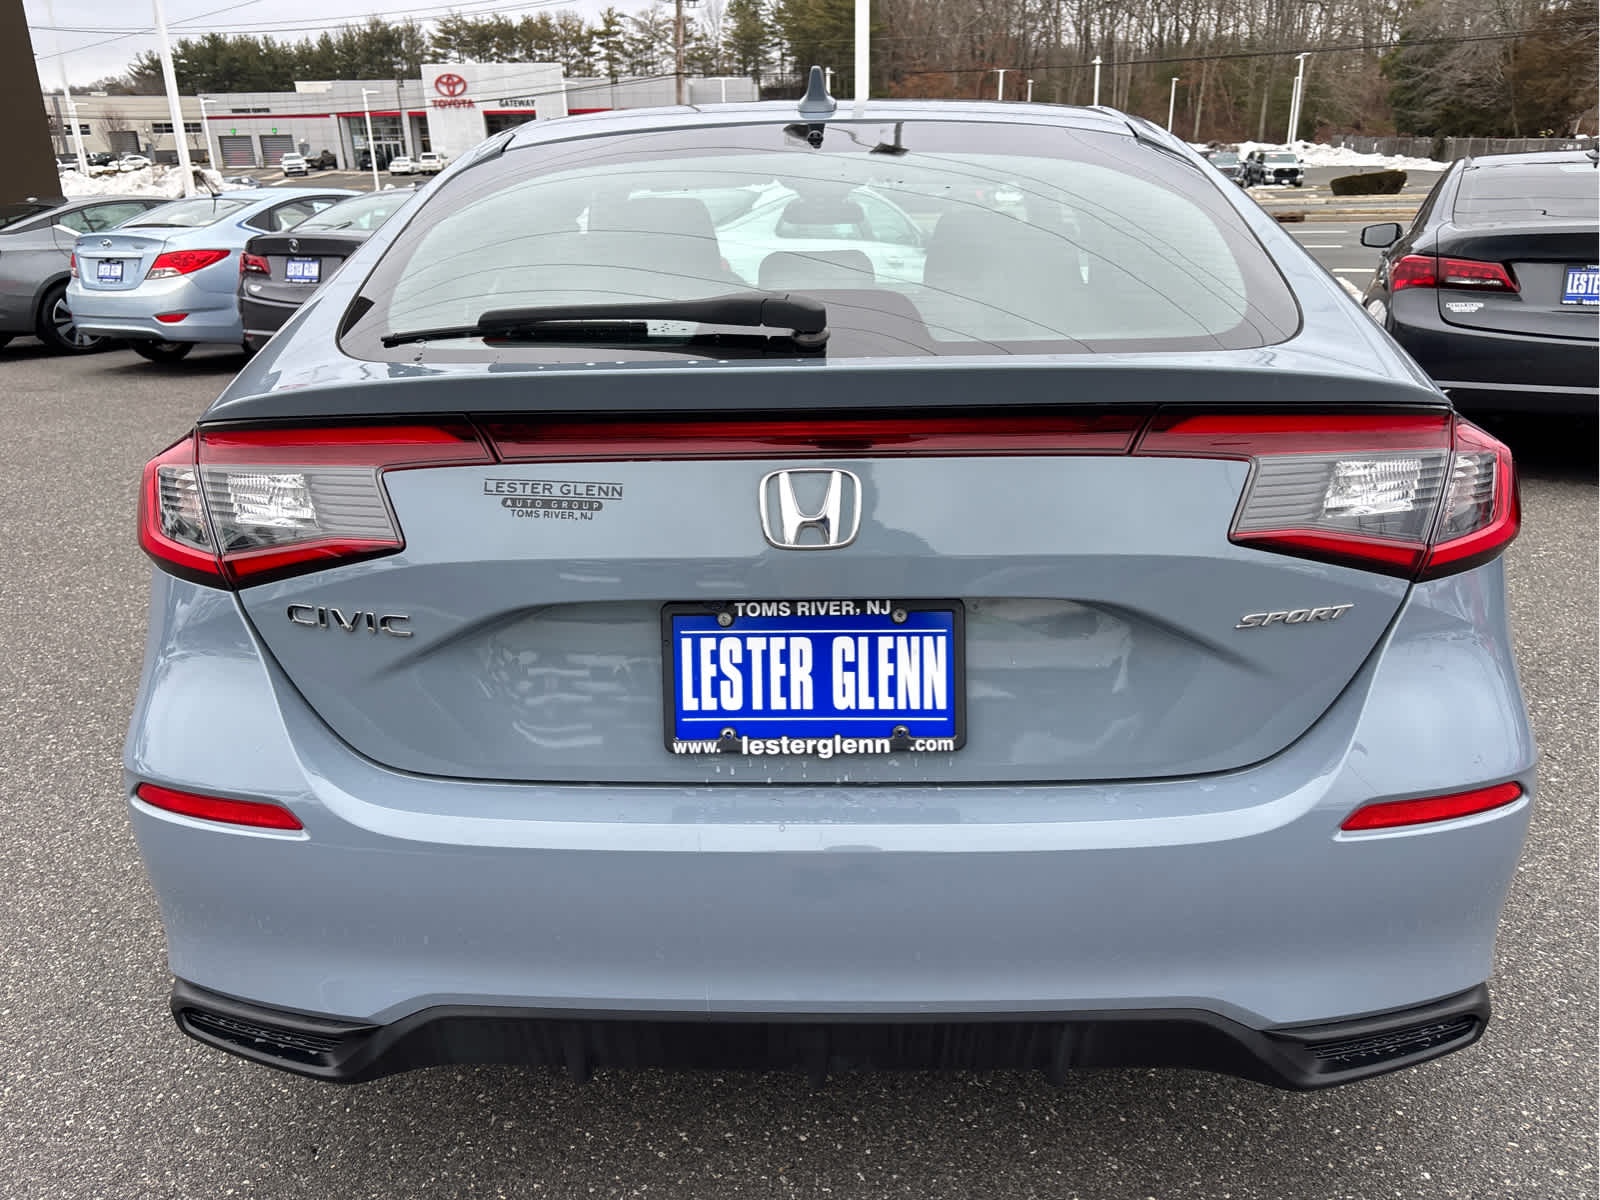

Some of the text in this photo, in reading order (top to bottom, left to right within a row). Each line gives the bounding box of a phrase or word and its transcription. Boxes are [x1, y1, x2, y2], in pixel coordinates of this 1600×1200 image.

[432, 99, 475, 109] TOYOTA
[499, 99, 536, 108] GATEWAY
[483, 481, 623, 497] LESTER GLENN
[505, 499, 600, 509] AUTO GROUP
[511, 509, 540, 519] TOMS
[580, 512, 593, 521] NJ
[734, 600, 892, 617] TOMS RIVER, NJ
[1235, 602, 1354, 629] SPORT
[287, 603, 413, 637] CIVIC
[681, 635, 947, 711] LESTER GLENN
[673, 735, 955, 759] www. lesterglenn .com
